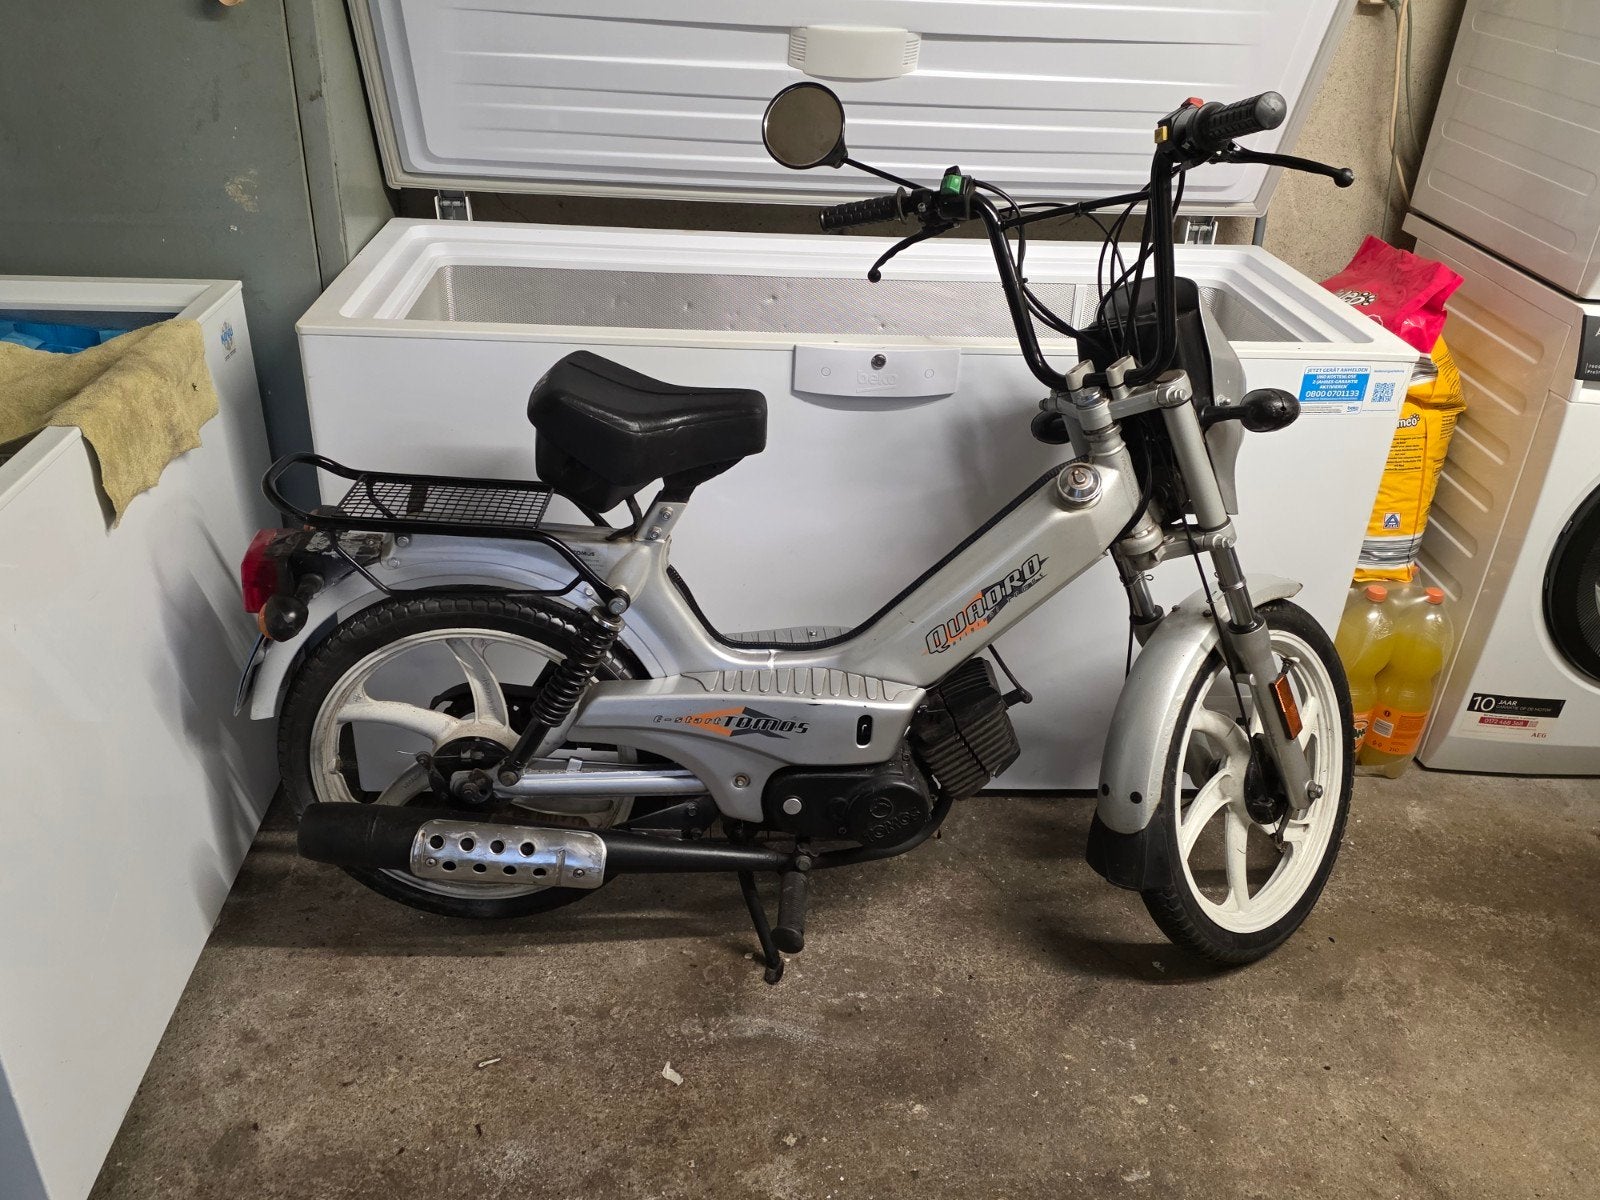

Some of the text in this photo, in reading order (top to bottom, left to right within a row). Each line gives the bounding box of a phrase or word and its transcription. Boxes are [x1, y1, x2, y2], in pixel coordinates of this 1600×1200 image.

[857, 370, 897, 385] beko
[1305, 390, 1326, 398] 0800
[925, 553, 1042, 655] QUADRO
[1473, 696, 1496, 712] 10
[723, 715, 810, 734] TOMOS
